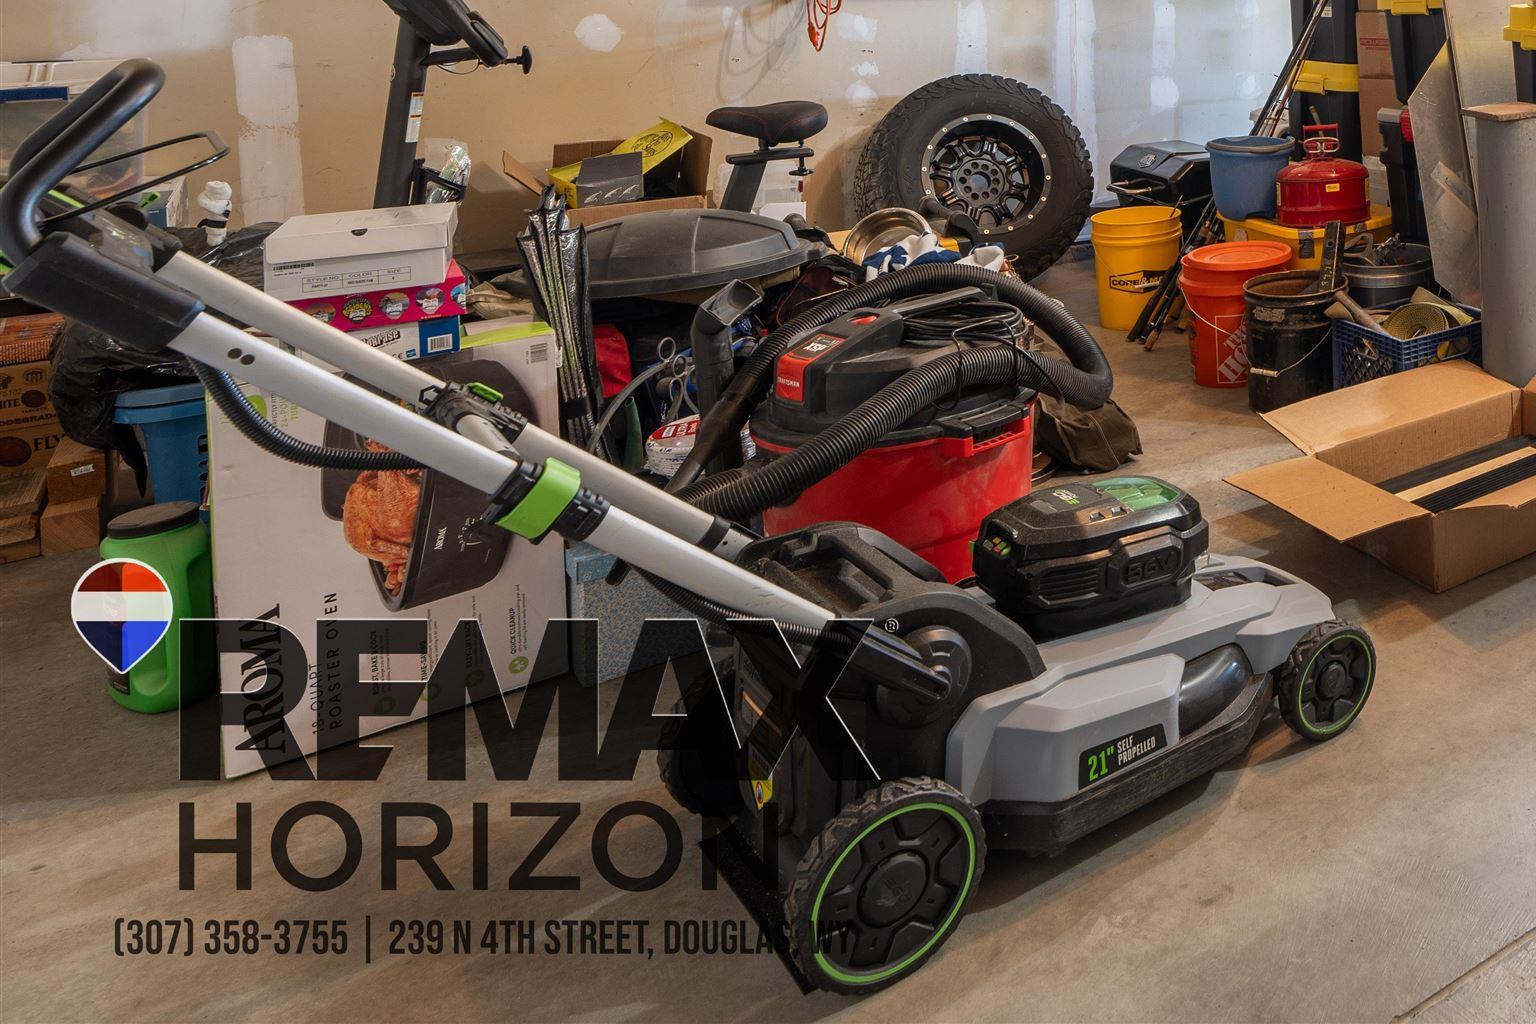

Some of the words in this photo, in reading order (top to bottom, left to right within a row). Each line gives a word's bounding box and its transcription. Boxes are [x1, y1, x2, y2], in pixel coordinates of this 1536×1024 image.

[777, 376, 800, 388] CRAFTSMAN
[1127, 551, 1175, 578] 56V
[234, 602, 286, 754] AROMA
[326, 647, 343, 730] ROASTER
[1087, 745, 1115, 782] 21"
[1118, 736, 1156, 766] PROPELLED
[1117, 735, 1134, 754] SELF
